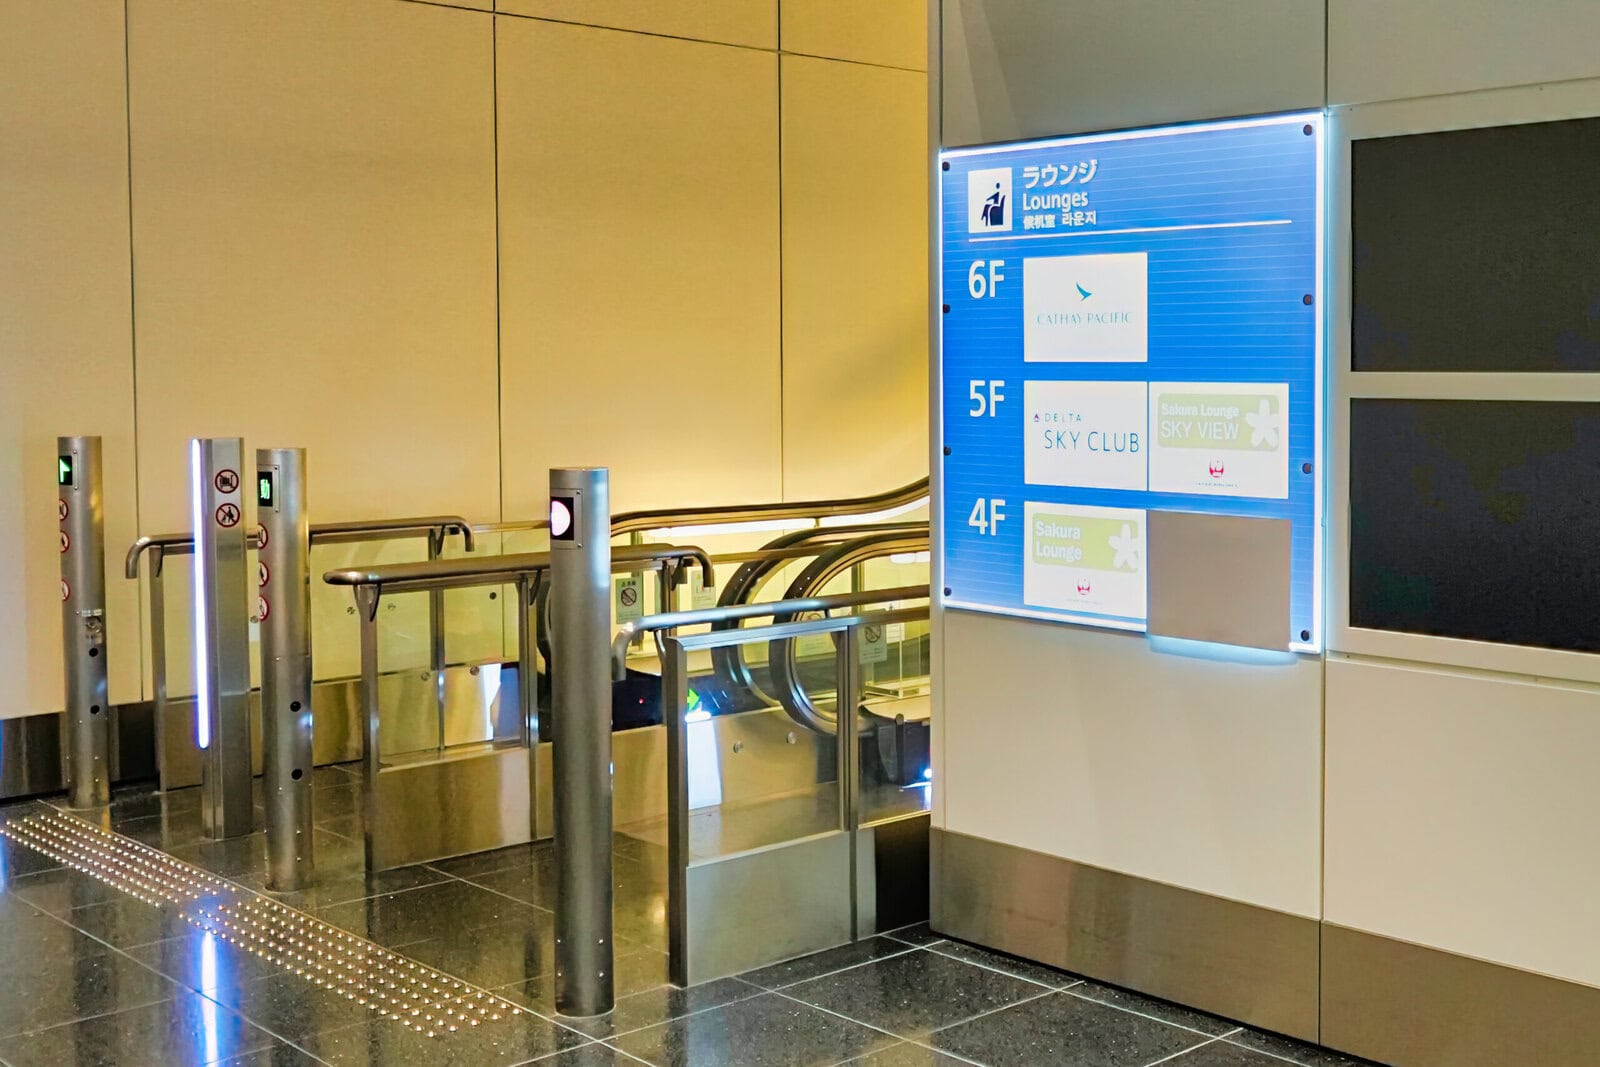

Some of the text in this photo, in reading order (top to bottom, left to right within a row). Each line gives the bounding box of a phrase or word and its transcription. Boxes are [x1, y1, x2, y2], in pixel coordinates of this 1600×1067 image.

[1022, 159, 1098, 189] ラウンジ
[1022, 191, 1089, 212] Lounges
[1061, 210, 1097, 227] 라운지
[968, 259, 1005, 299] 6F
[1036, 311, 1135, 325] CATHAY PACIFIC
[969, 379, 1005, 418] 5F
[1044, 412, 1082, 423] DELTA
[1160, 403, 1240, 419] Sakura Lounge
[1160, 420, 1239, 440] SKY VIEW
[1044, 429, 1140, 453] SKY CLUB
[968, 497, 1007, 536] 4F
[1035, 520, 1082, 541] Sakura
[1035, 541, 1083, 563] Lounge
